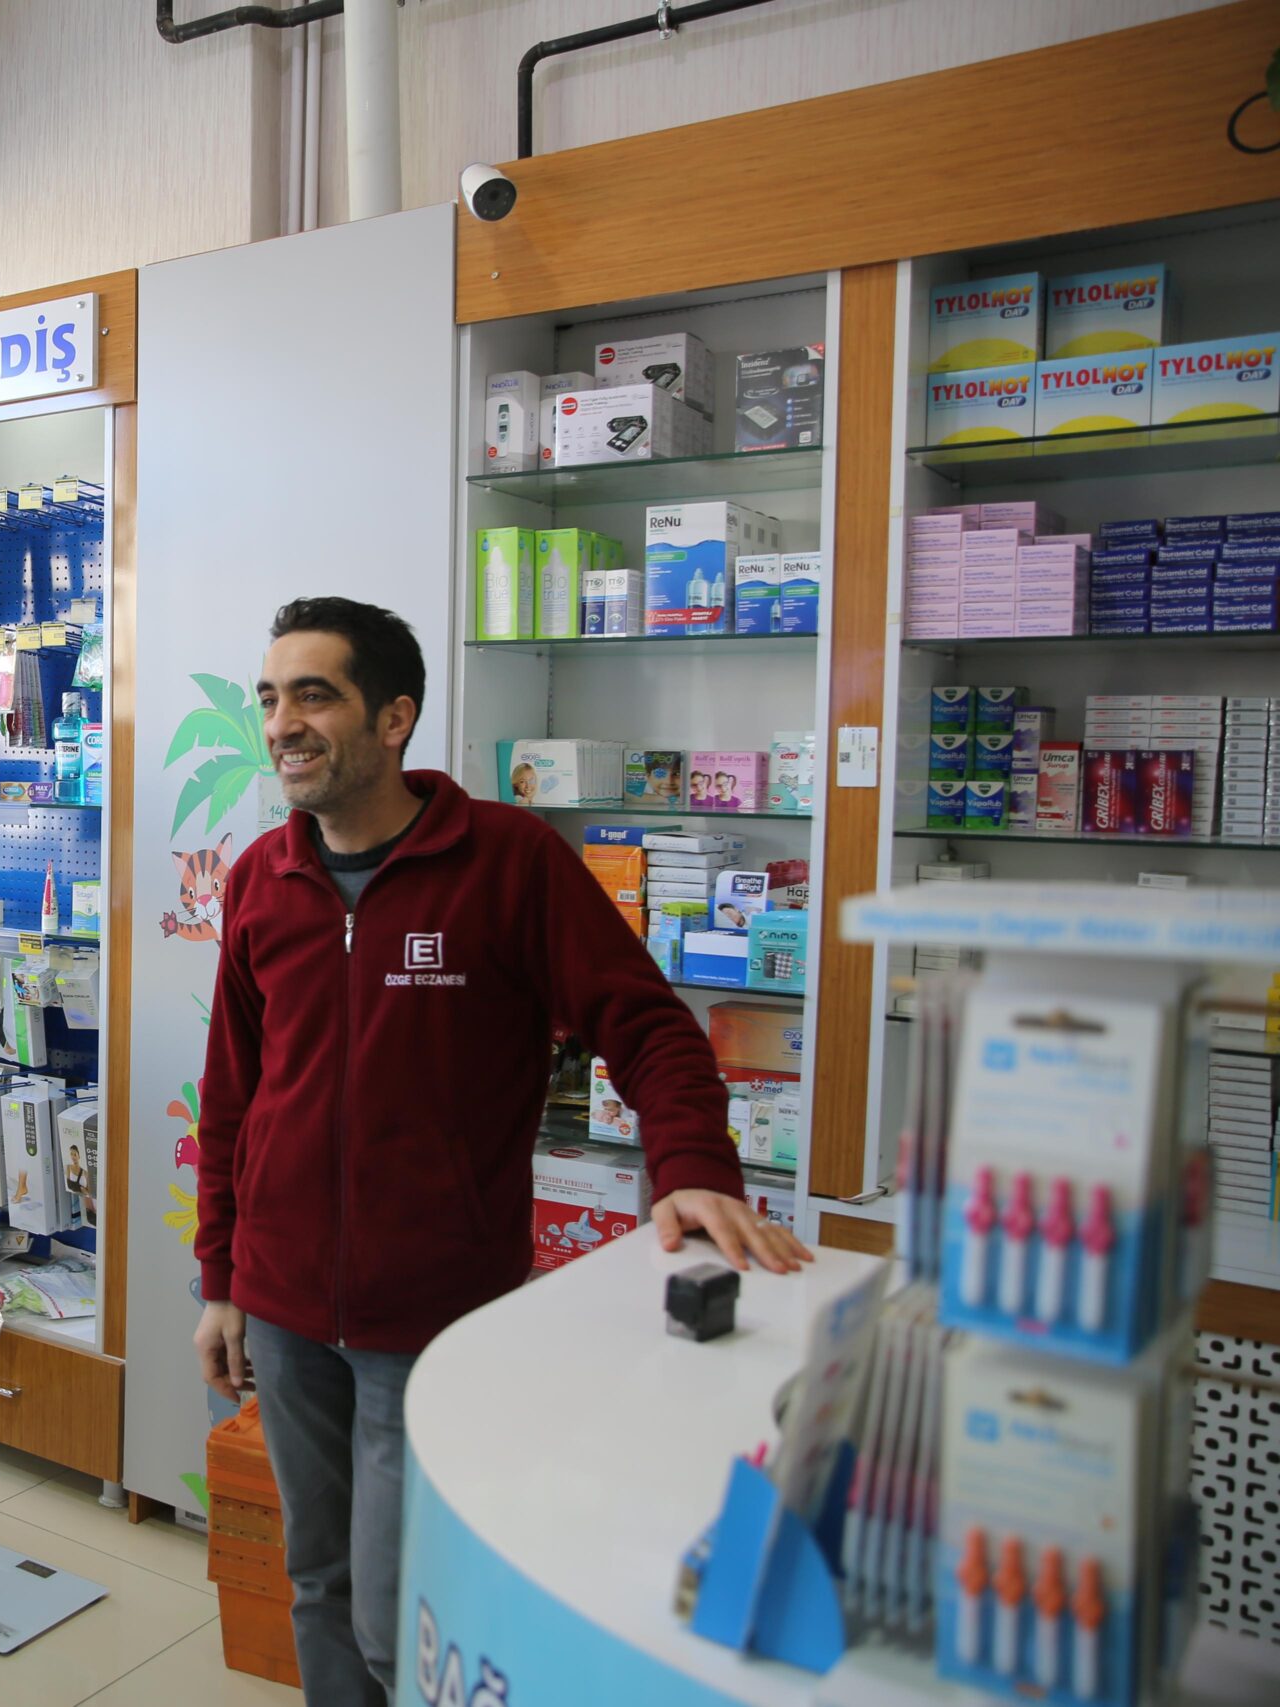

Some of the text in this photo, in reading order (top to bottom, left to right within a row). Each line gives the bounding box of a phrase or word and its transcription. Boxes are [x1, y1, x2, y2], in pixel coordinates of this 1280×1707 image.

[1127, 298, 1150, 310] DAY
[1003, 307, 1026, 317] DAY
[0, 314, 76, 383] DİŞ
[1240, 369, 1267, 381] DAY
[1115, 383, 1140, 395] DAY
[1000, 396, 1022, 407] DAY
[649, 516, 681, 529] ReNu
[738, 564, 764, 574] ReNu
[783, 562, 810, 572] ReNu
[1042, 753, 1075, 763] Umca
[734, 876, 762, 884] Breathe
[743, 884, 762, 893] Right
[412, 939, 434, 963] E
[384, 973, 412, 986] ÖZGE
